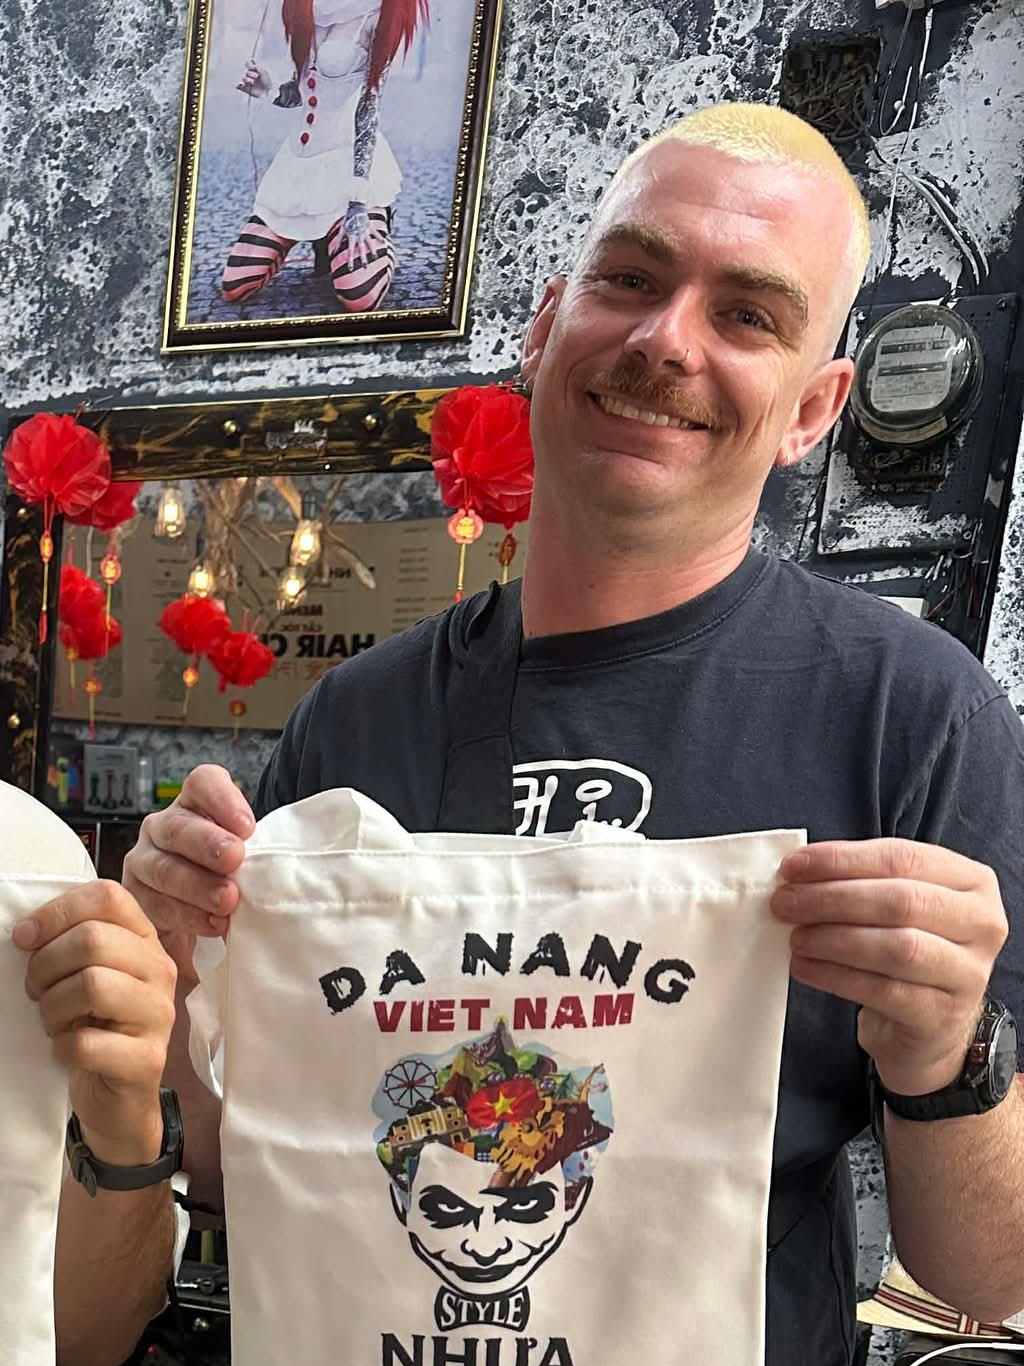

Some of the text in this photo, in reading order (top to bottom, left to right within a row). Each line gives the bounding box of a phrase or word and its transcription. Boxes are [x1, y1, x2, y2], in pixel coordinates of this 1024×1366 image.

[319, 931, 695, 1015] DA NANG
[373, 993, 635, 1032] VIET NAM
[440, 1292, 525, 1327] STYLE
